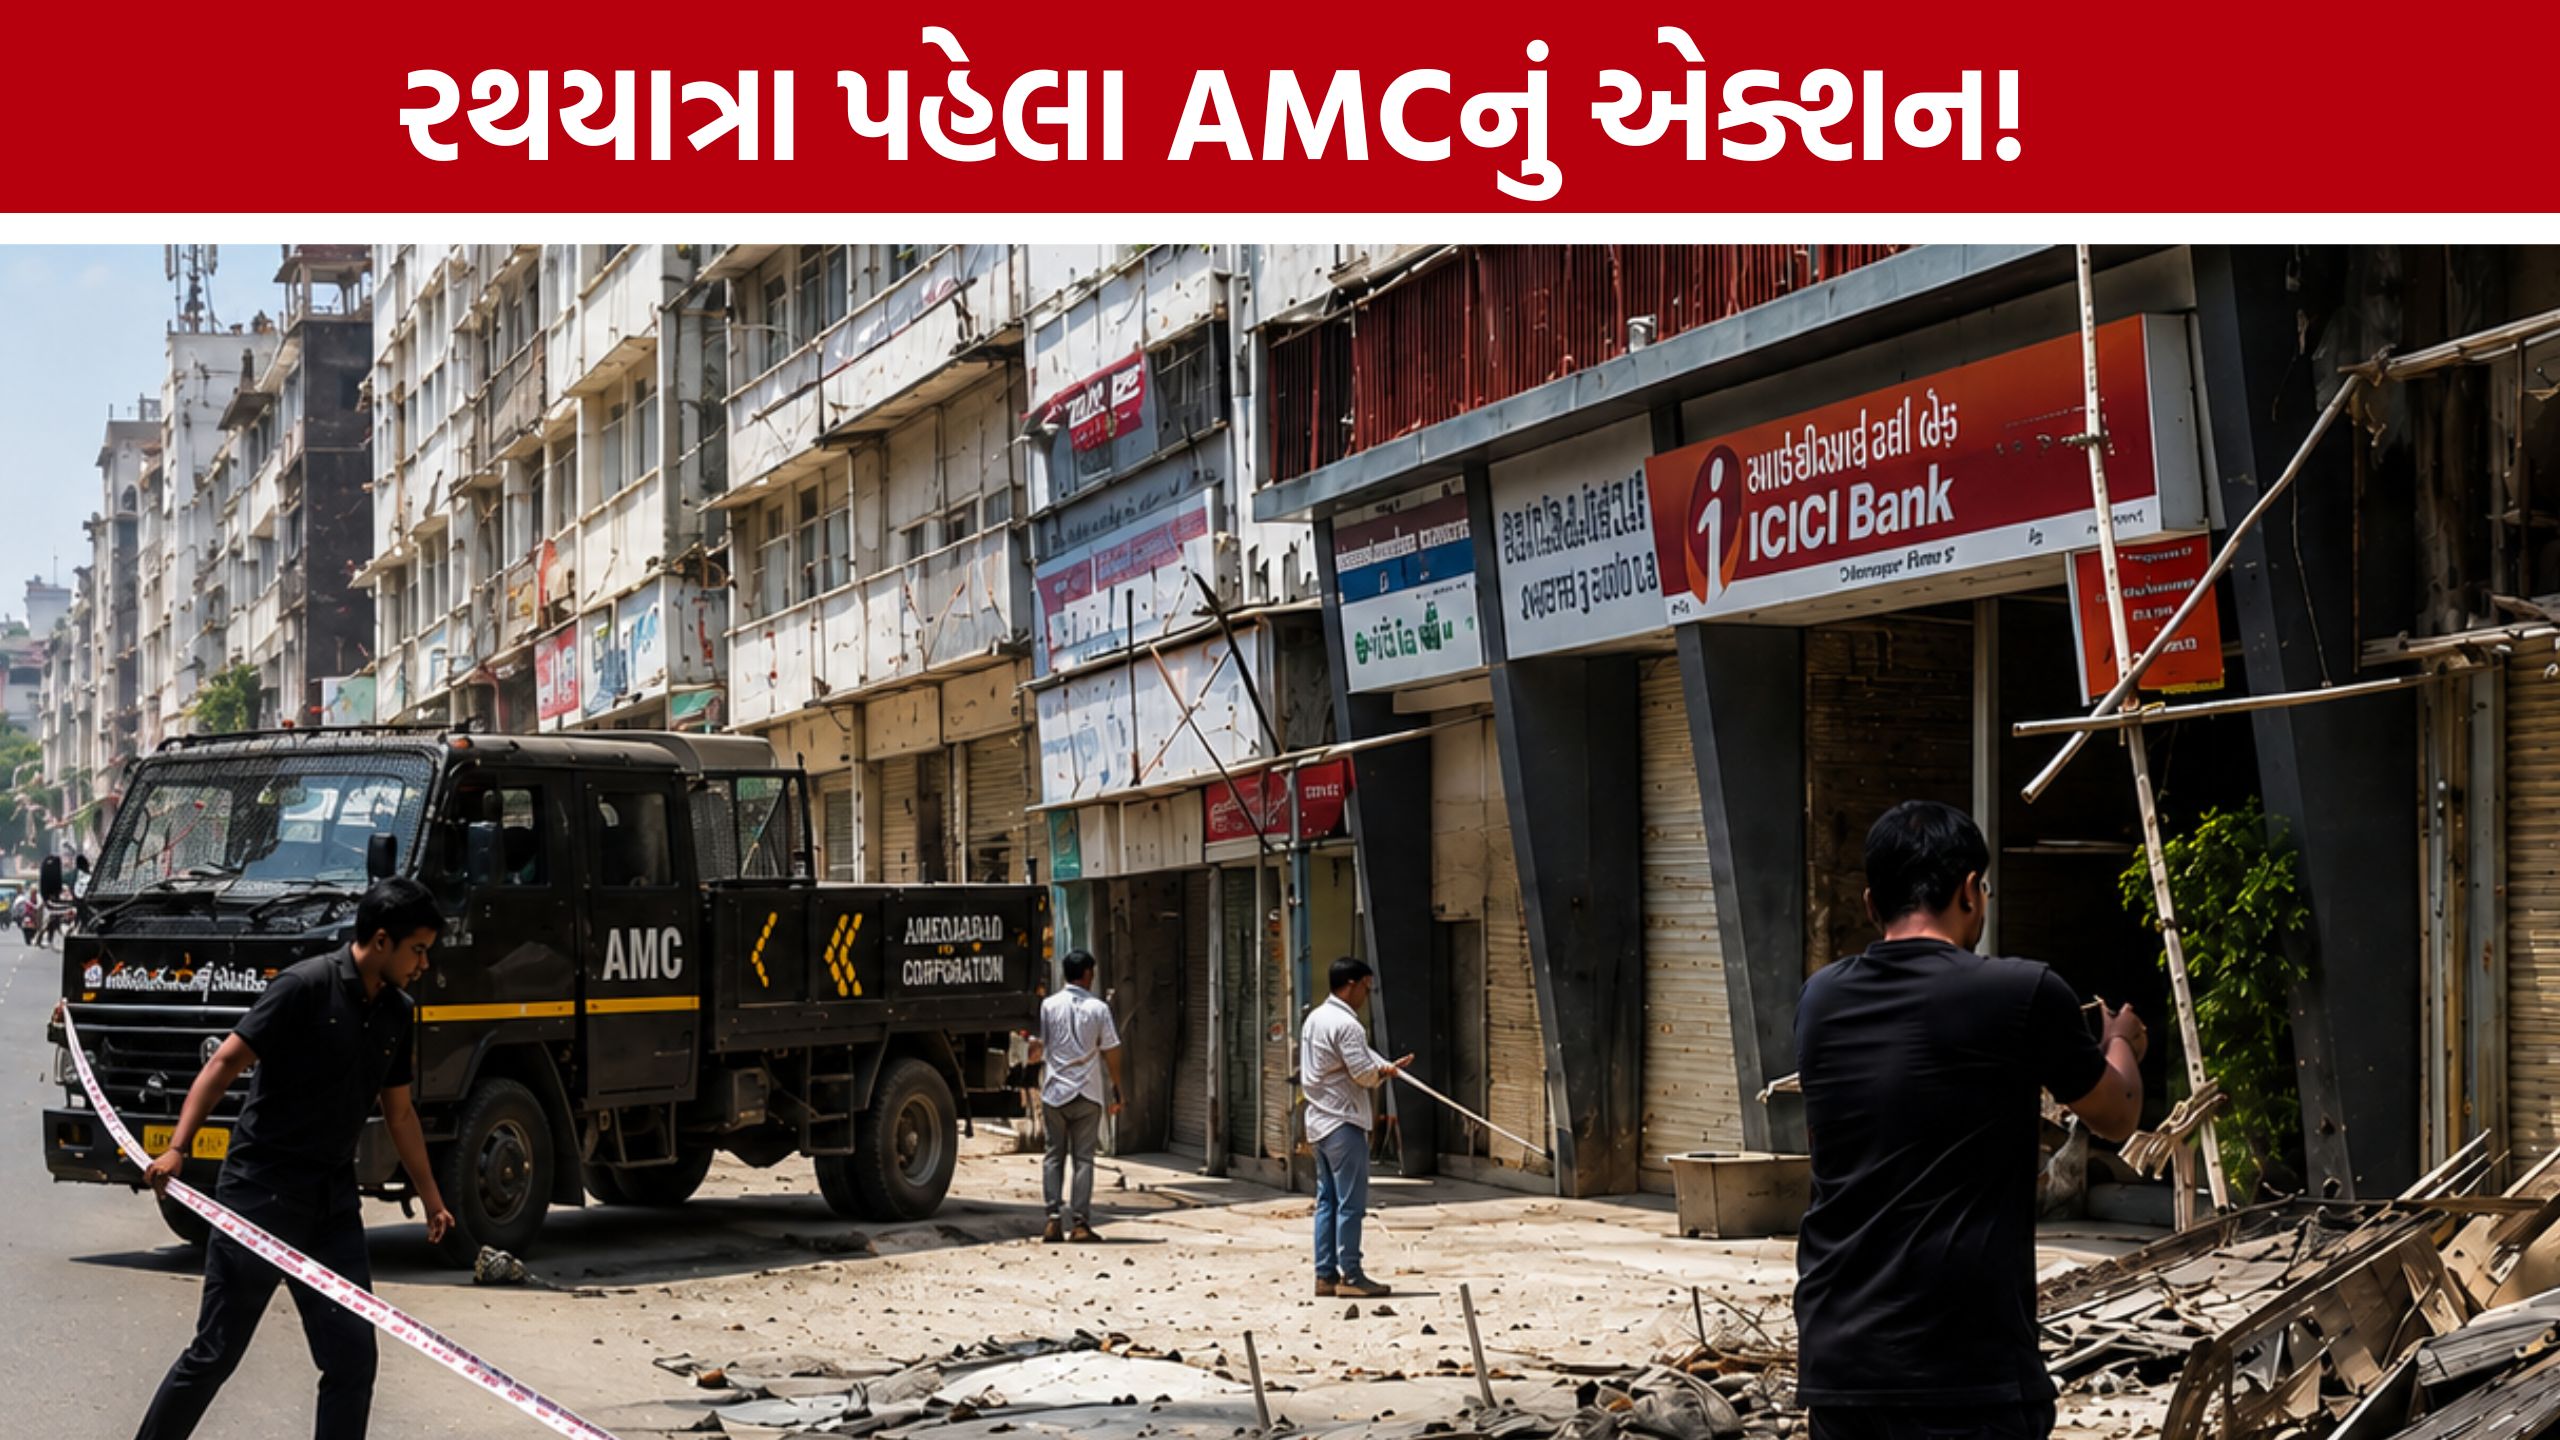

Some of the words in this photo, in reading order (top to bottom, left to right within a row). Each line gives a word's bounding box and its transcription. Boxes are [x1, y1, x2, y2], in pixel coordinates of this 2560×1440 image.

[1748, 489, 1839, 562] ICICI
[1848, 463, 1955, 541] Bank
[603, 928, 682, 979] AMC
